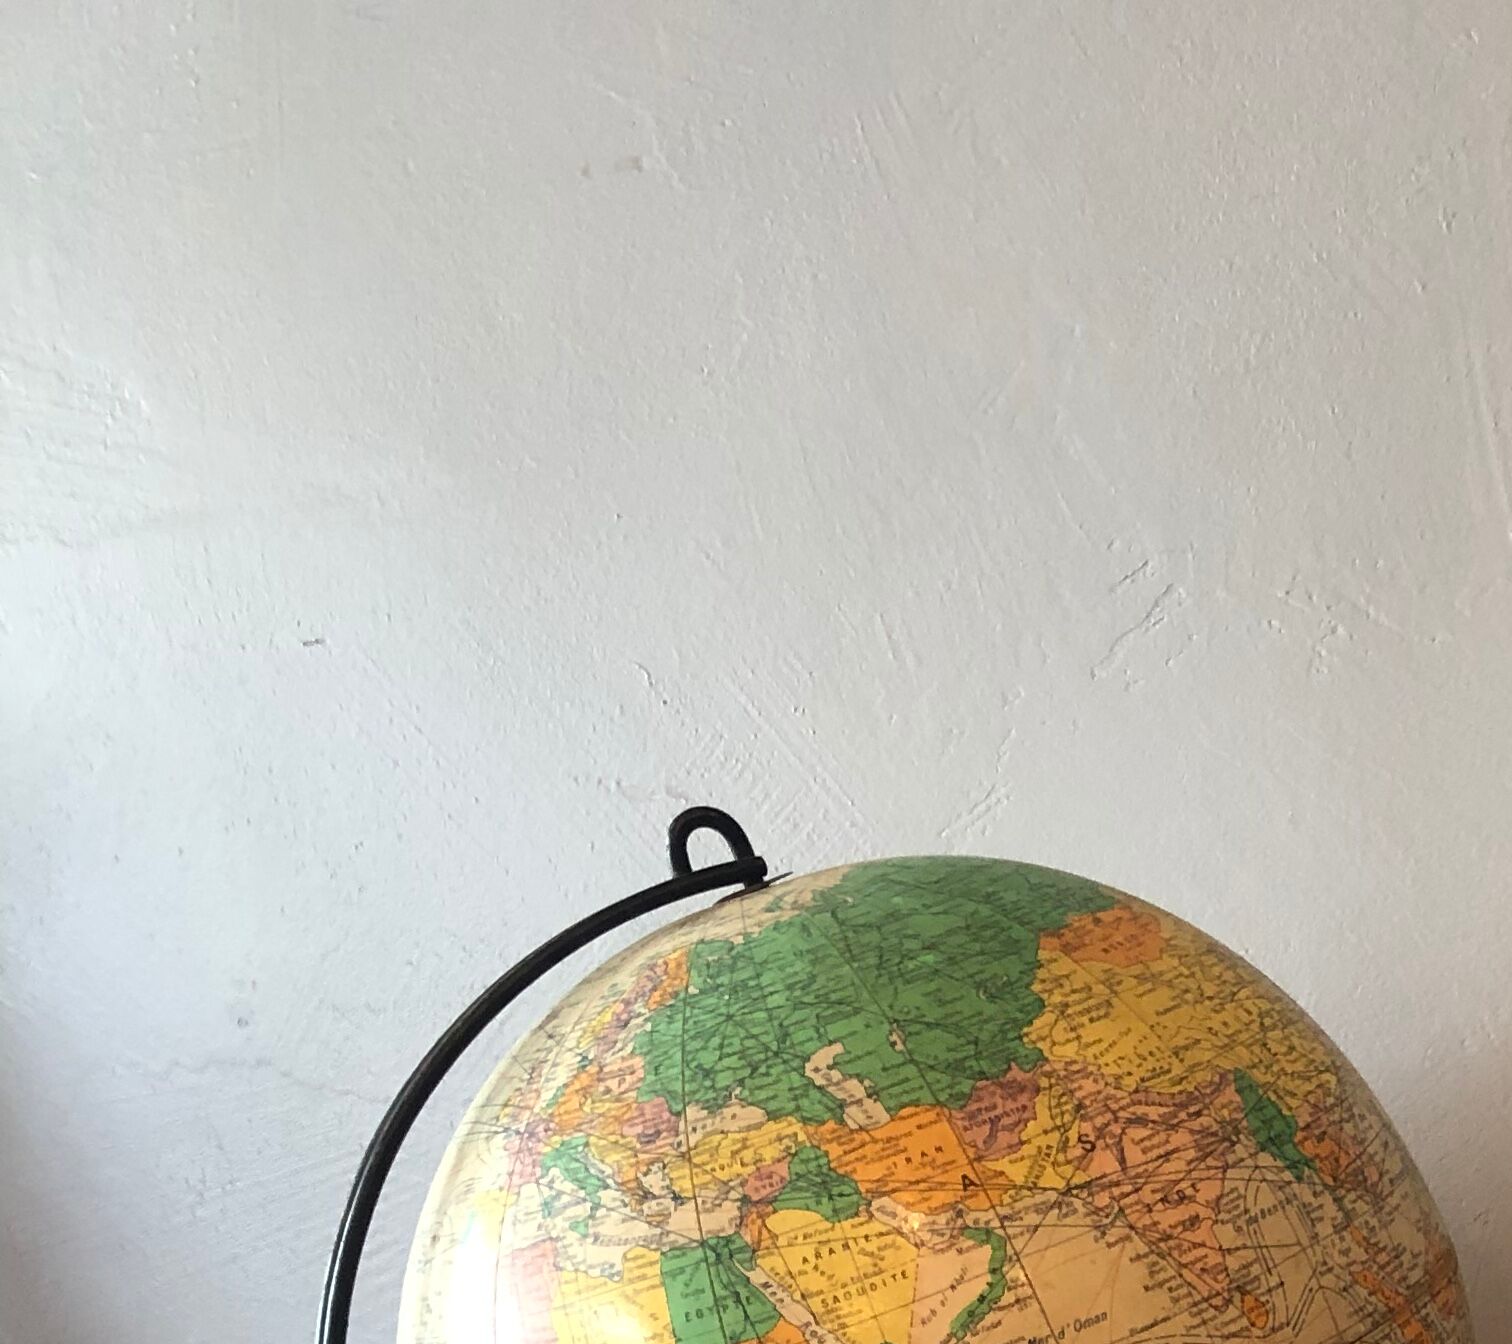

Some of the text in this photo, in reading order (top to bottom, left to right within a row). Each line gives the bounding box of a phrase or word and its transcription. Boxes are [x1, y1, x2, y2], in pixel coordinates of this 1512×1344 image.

[892, 1145, 944, 1169] IRAN
[801, 1233, 872, 1265] ARABIE
[820, 1269, 909, 1309] SAOUDITE
